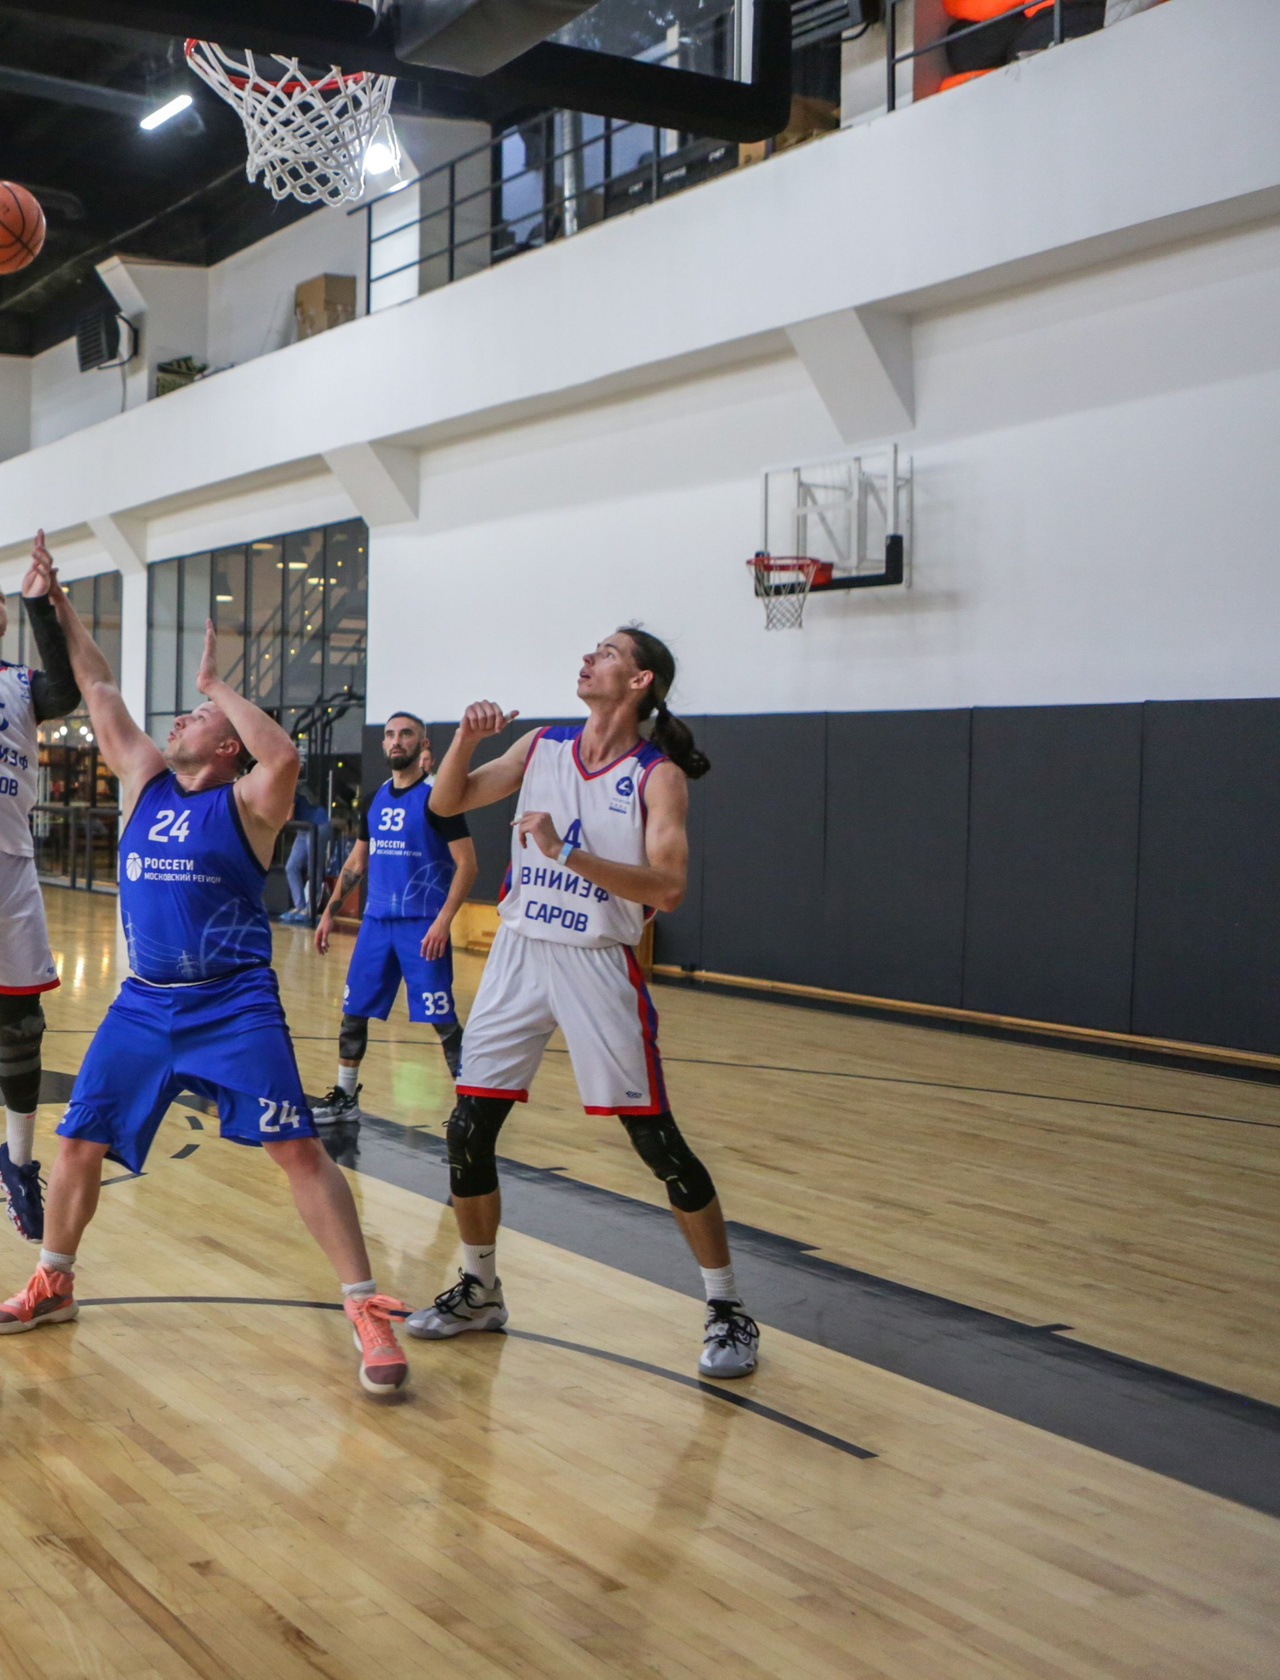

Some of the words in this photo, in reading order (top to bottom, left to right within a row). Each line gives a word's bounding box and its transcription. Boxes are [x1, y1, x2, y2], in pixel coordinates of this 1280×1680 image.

[147, 809, 192, 843] 24
[378, 806, 406, 832] 33
[376, 839, 406, 849] РОССЕТИ
[563, 818, 582, 849] 4
[144, 857, 194, 871] РОССЕТИ
[144, 872, 191, 882] МОСКОВСКИЙ
[192, 873, 222, 884] РЕГИОН
[521, 866, 610, 904] ВНИИЭФ
[524, 900, 589, 932] САРОВ
[422, 991, 450, 1015] 33
[257, 1097, 300, 1133] 24
